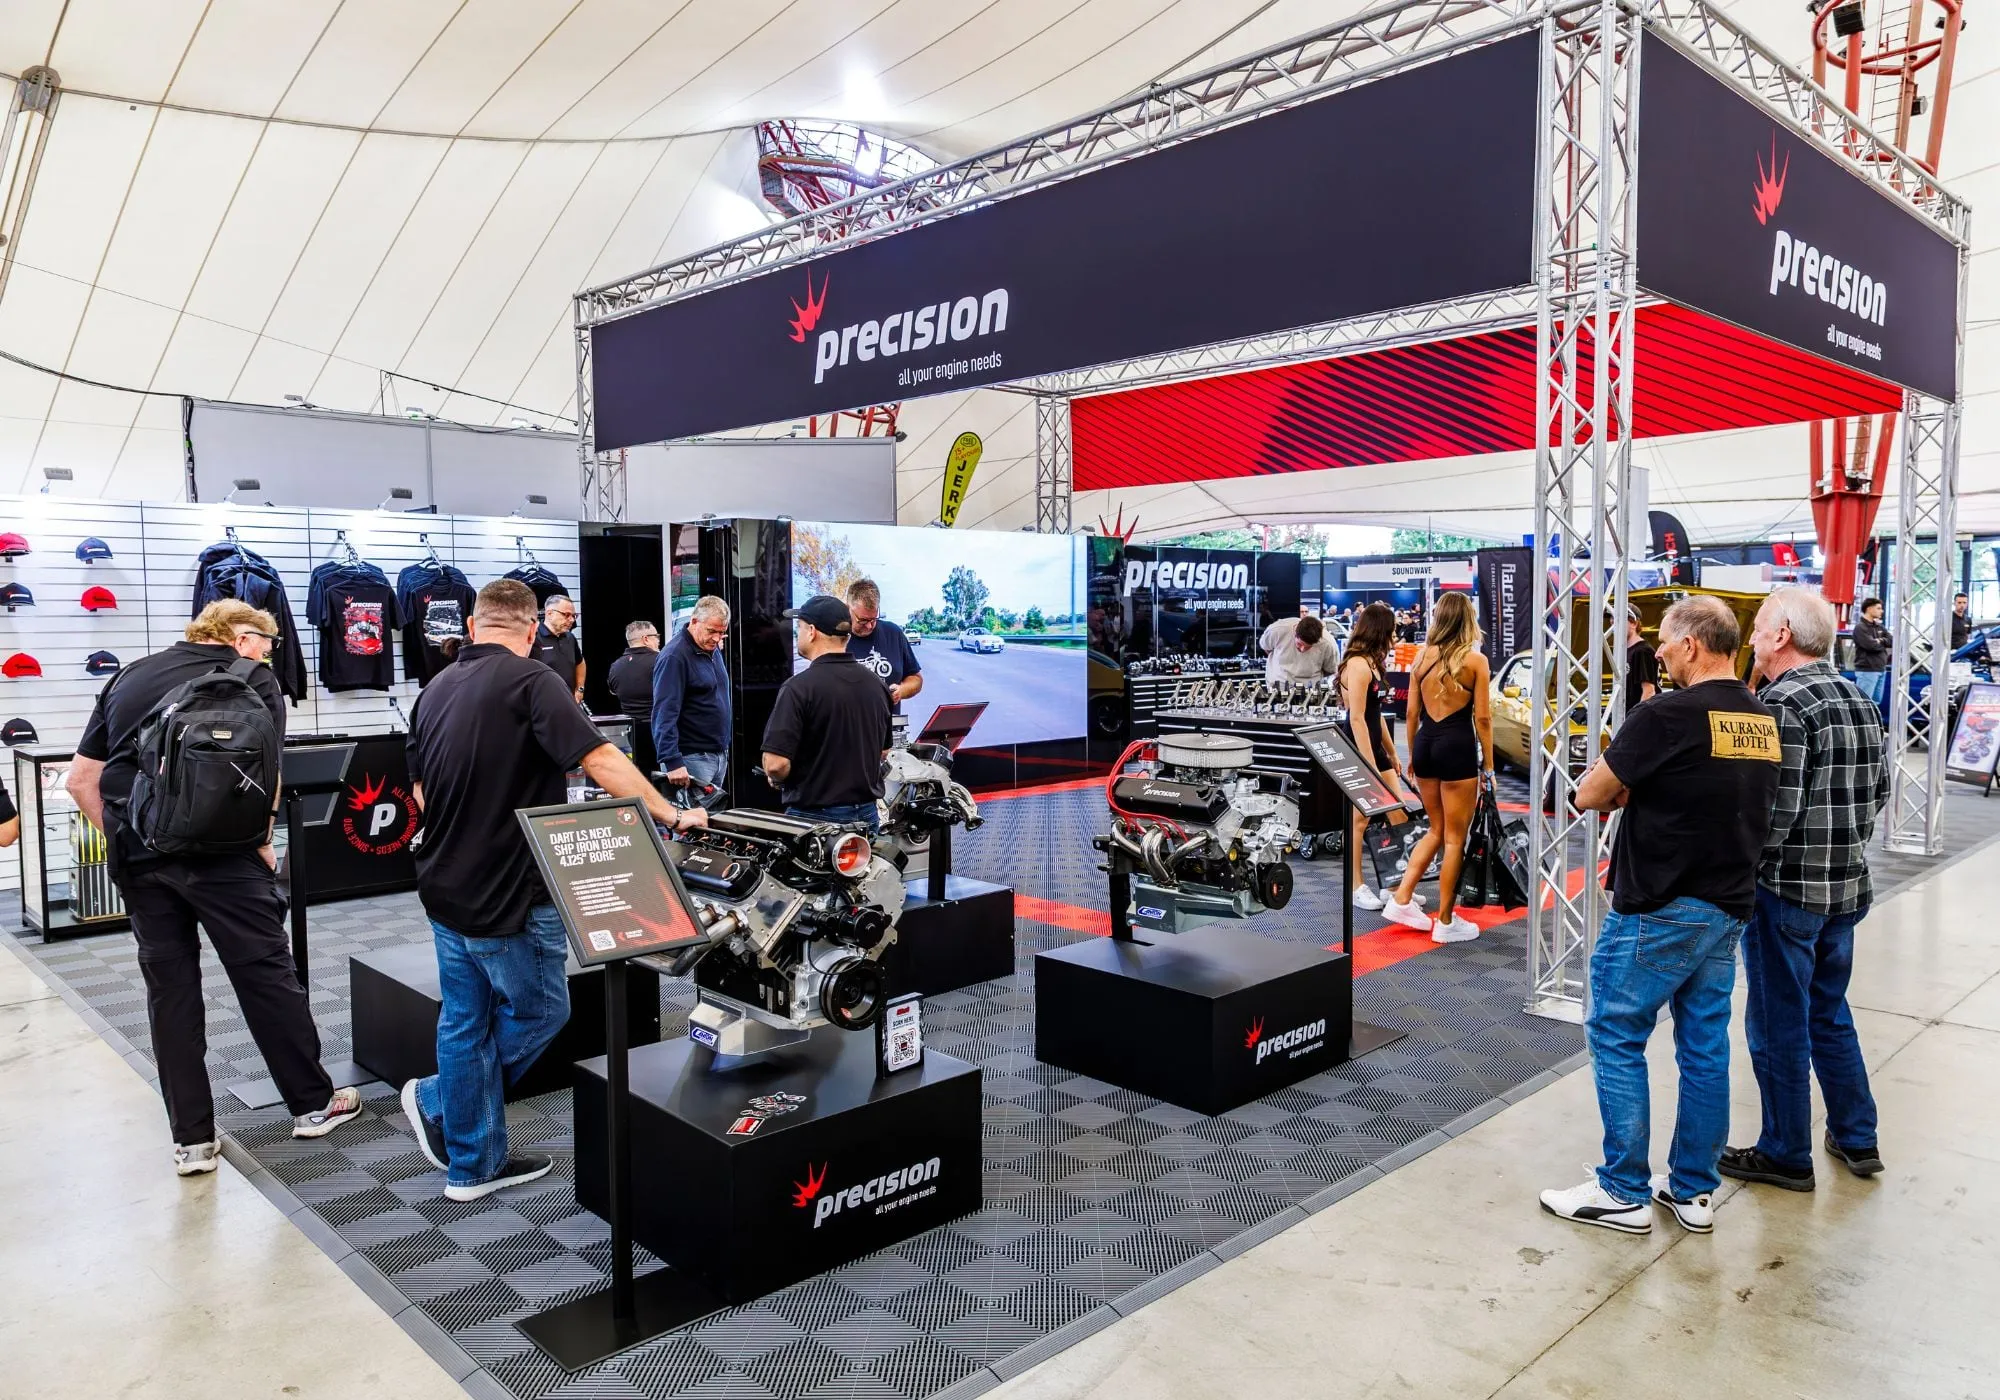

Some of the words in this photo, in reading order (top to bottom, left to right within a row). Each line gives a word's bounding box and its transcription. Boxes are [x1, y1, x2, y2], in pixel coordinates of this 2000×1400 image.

[1769, 230, 1887, 327] precision
[814, 288, 1009, 384] precision
[1827, 324, 1836, 343] all
[1835, 329, 1849, 348] your
[1848, 334, 1866, 356] engine
[1865, 342, 1882, 361] needs
[898, 367, 911, 386] all
[912, 365, 934, 386] your
[935, 358, 969, 380] engine
[970, 350, 1002, 373] needs
[1123, 560, 1249, 597] precision
[1391, 566, 1432, 576] SOUNDWAVE
[1184, 599, 1193, 610] all
[1193, 601, 1207, 611] your
[1207, 598, 1227, 611] engine
[1227, 598, 1245, 610] needs
[1719, 720, 1775, 738] KURANDA
[1732, 735, 1770, 750] HOTEL
[391, 786, 405, 799] ALL
[1143, 788, 1181, 798] precision
[403, 796, 418, 816] YOUR
[343, 818, 354, 835] 1970
[369, 803, 397, 836] P
[400, 817, 418, 844] ENGINE
[550, 830, 575, 845] DART
[576, 829, 588, 842] LS
[589, 826, 612, 840] NEXT
[347, 834, 370, 853] SINCE
[376, 840, 402, 855] NEEDS
[554, 843, 575, 856] SHP
[576, 839, 600, 853] IRON
[601, 836, 631, 851] BLOCK
[589, 850, 615, 863] BORE
[1256, 1018, 1326, 1065] precision
[813, 1156, 941, 1229] precision
[875, 1205, 884, 1215] all
[884, 1200, 899, 1214] your
[898, 1192, 918, 1206] engine
[918, 1185, 937, 1198] needs
